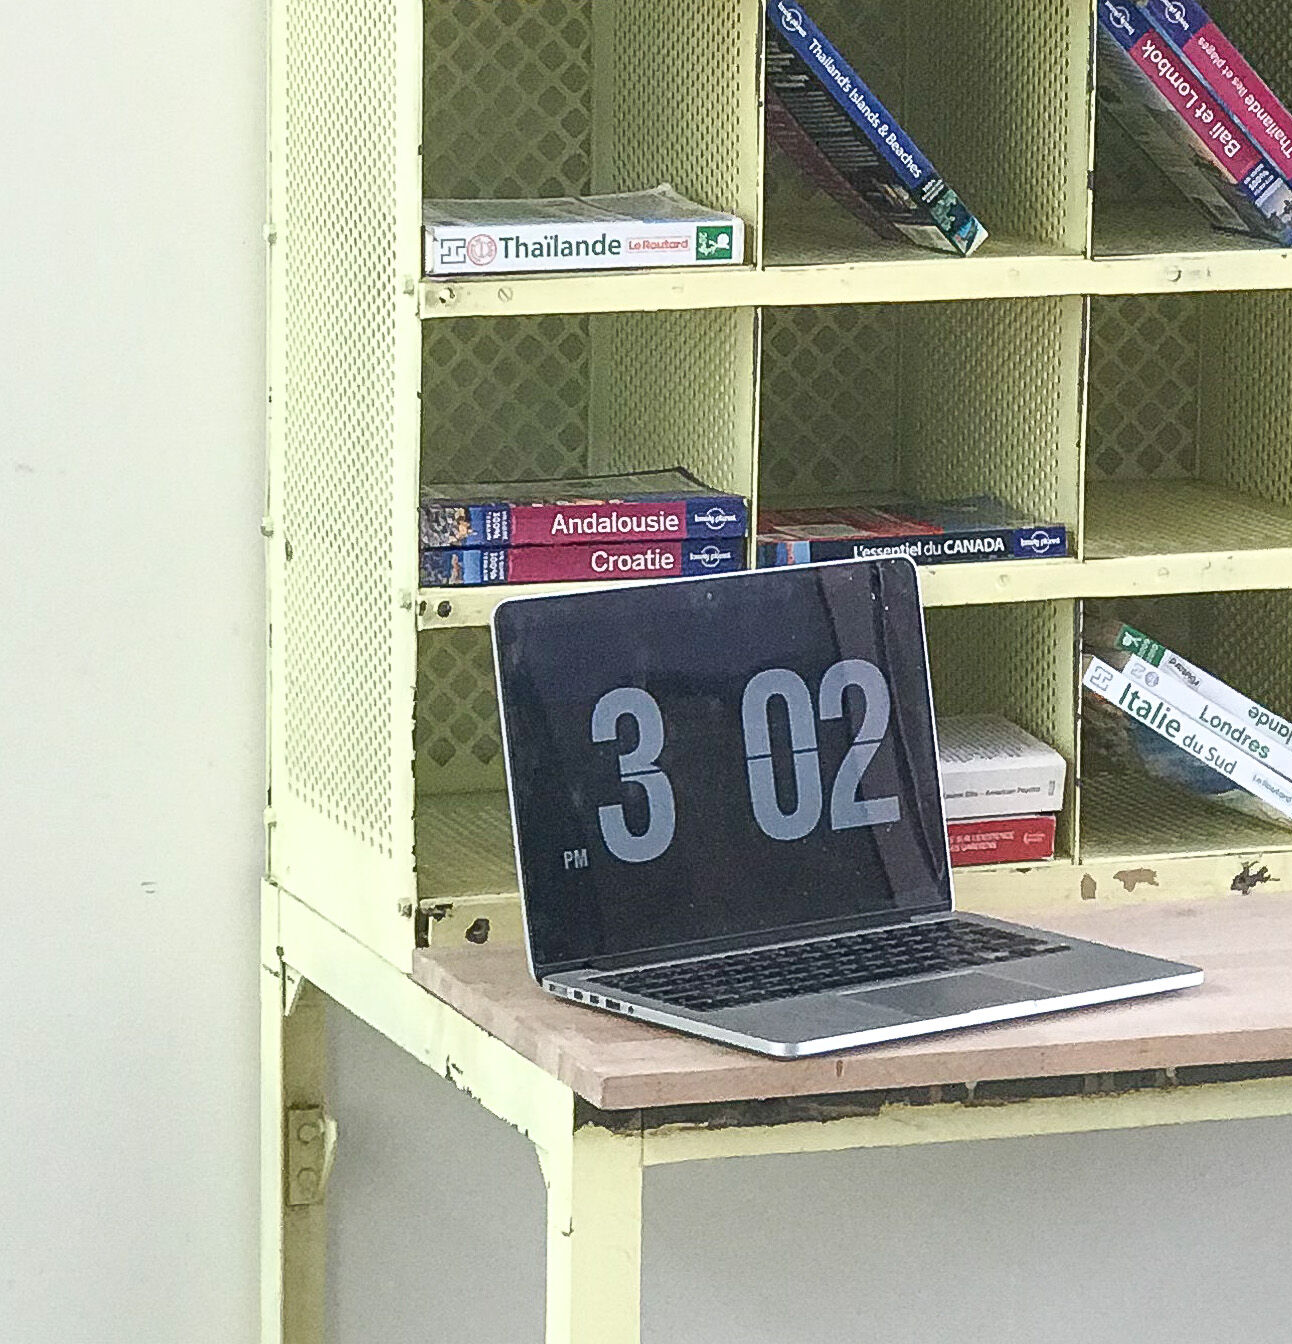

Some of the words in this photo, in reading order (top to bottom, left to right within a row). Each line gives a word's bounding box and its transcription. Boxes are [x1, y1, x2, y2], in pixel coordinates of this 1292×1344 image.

[1197, 36, 1226, 68] plages
[1141, 39, 1198, 108] Lombok
[1220, 65, 1233, 78] et
[808, 37, 851, 92] Thailand's
[848, 88, 880, 128] Islands
[877, 123, 888, 137] &
[885, 132, 921, 178] Beaches
[1194, 102, 1213, 122] et
[1208, 121, 1240, 157] Bali
[498, 234, 622, 259] Thaïlande
[550, 511, 680, 536] Andalousie
[923, 541, 942, 556] du
[943, 537, 1005, 554] CANADA
[590, 549, 675, 573] Croatie
[1118, 682, 1180, 738] Italie
[1182, 734, 1203, 754] du
[1204, 746, 1237, 774] Sud
[1197, 705, 1269, 758] Londres
[591, 688, 676, 863] 3
[742, 658, 900, 842] 02
[563, 850, 588, 870] PM
